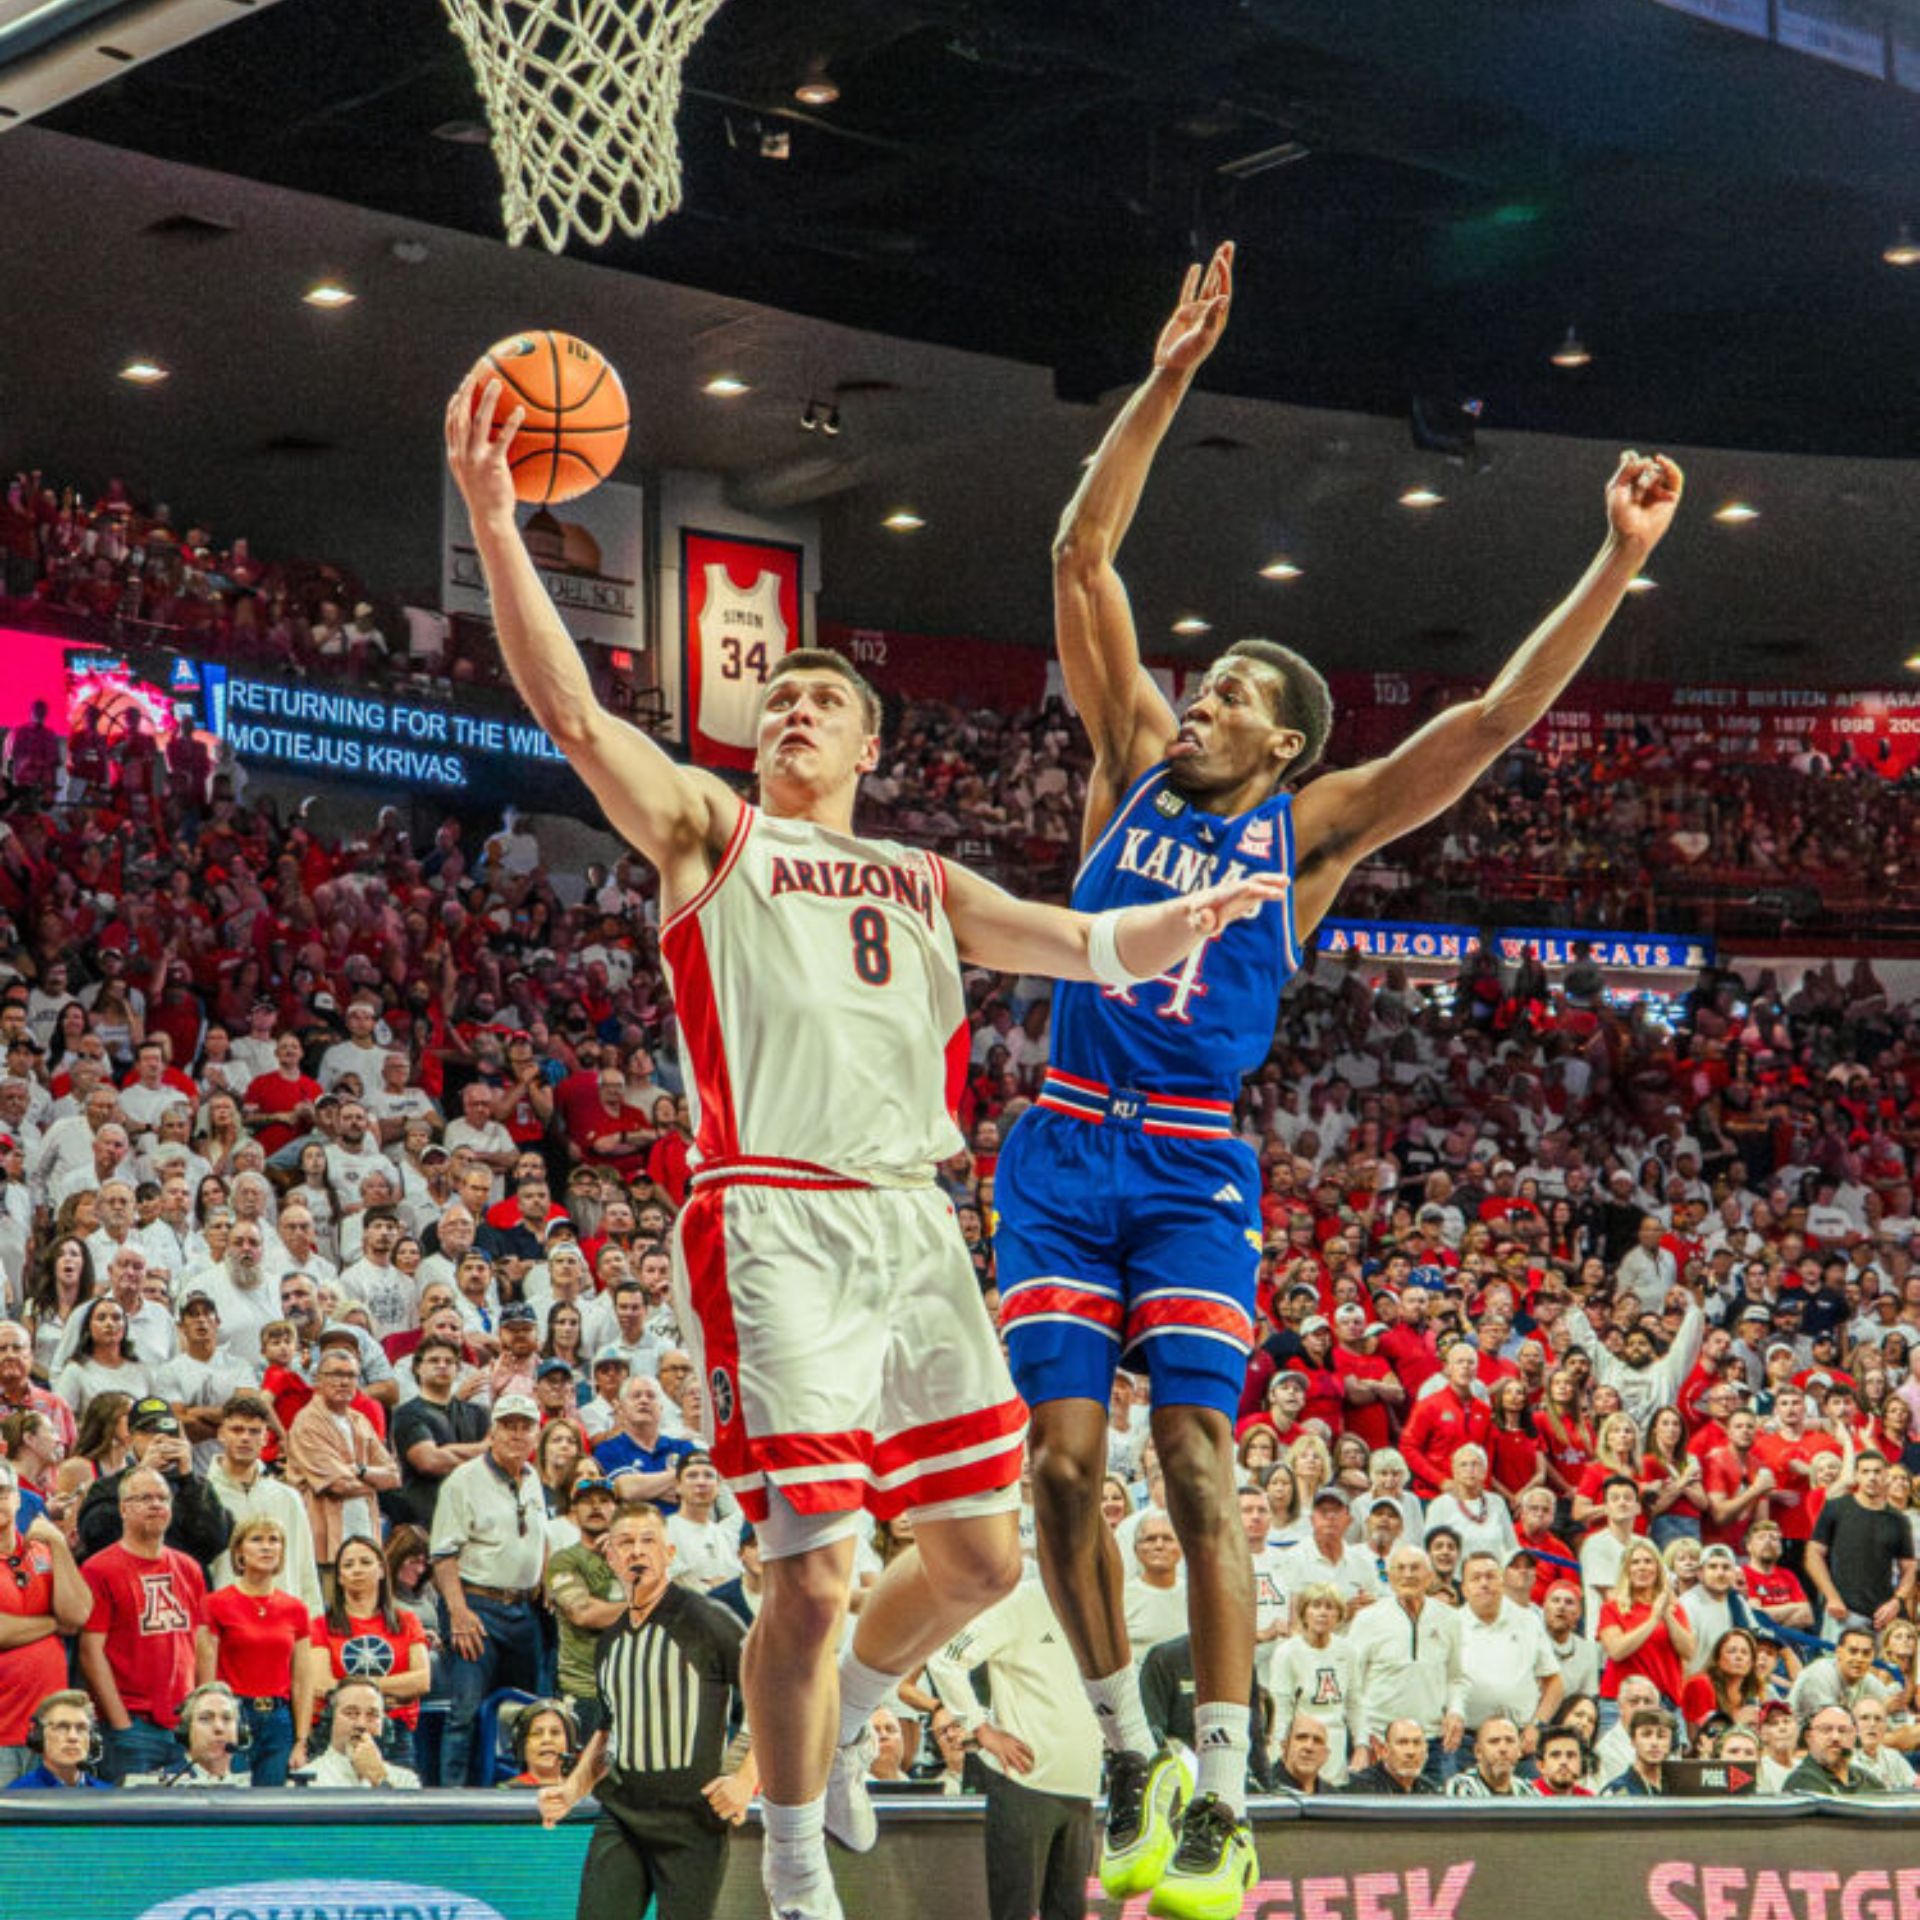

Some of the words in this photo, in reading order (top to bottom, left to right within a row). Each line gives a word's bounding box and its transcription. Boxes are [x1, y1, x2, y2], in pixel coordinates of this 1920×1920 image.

[724, 610, 763, 629] SIMON
[721, 637, 769, 683] 34
[850, 639, 887, 665] 102
[228, 680, 385, 731] RETURNING
[391, 707, 447, 740] FOR
[452, 715, 505, 749] THE
[1831, 717, 1875, 734] 1998
[227, 722, 362, 768] MOTIEJUS
[367, 744, 468, 785] KRIVAS.
[1116, 828, 1262, 917] KANSA
[850, 905, 892, 987] 8
[1330, 929, 1481, 957] ARIZONA
[140, 1573, 191, 1636] A
[1253, 1575, 1286, 1605] A
[1311, 1667, 1343, 1705] A
